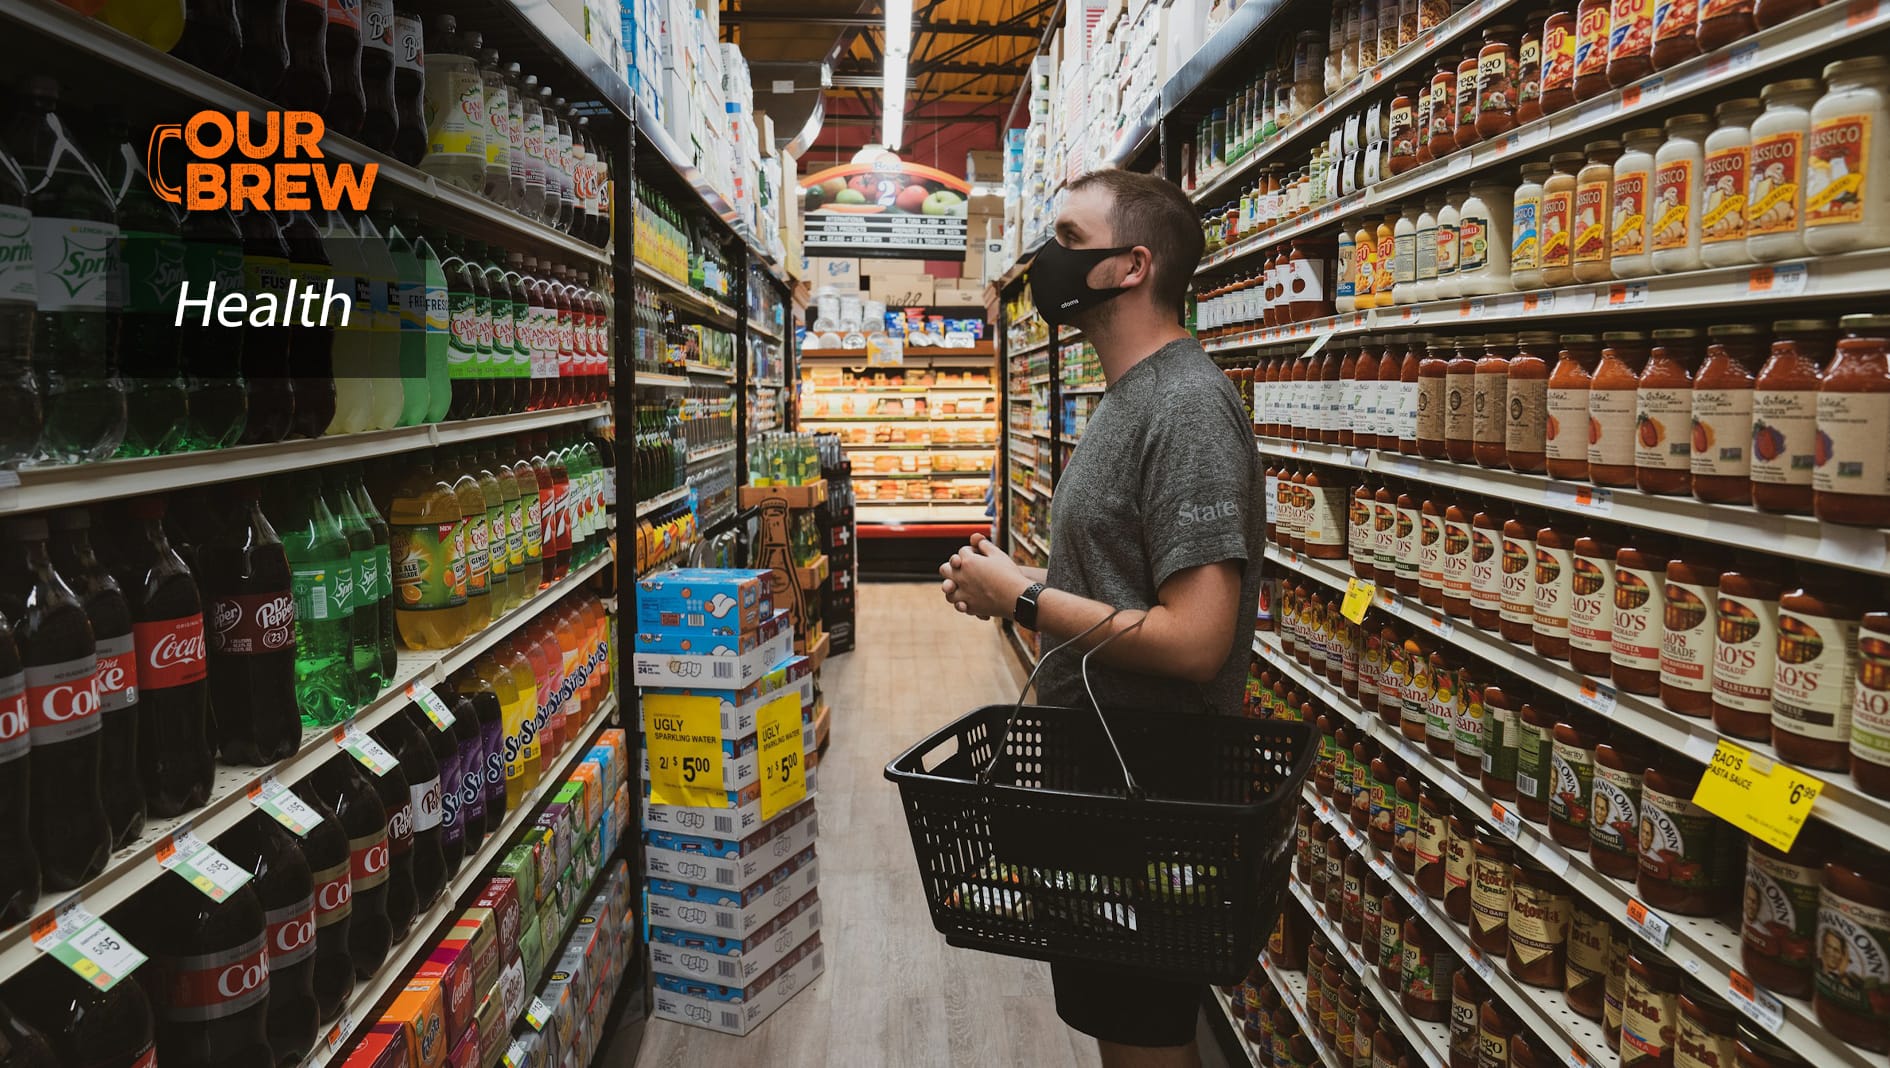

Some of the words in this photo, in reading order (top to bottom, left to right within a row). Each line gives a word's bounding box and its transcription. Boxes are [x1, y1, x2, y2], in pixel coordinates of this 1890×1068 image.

[1480, 58, 1501, 74] ego
[877, 180, 896, 207] 2
[1614, 610, 1647, 632] AO'S
[1715, 643, 1756, 669] AO'S
[1775, 665, 1819, 692] AO'S
[653, 718, 684, 732] UGLY
[762, 723, 780, 743] UGLY
[654, 731, 691, 743] SPARKLING
[692, 735, 717, 744] WATER
[1711, 748, 1744, 772] RAO'S
[1707, 764, 1729, 780] PASTA
[1729, 773, 1753, 791] SAUCE
